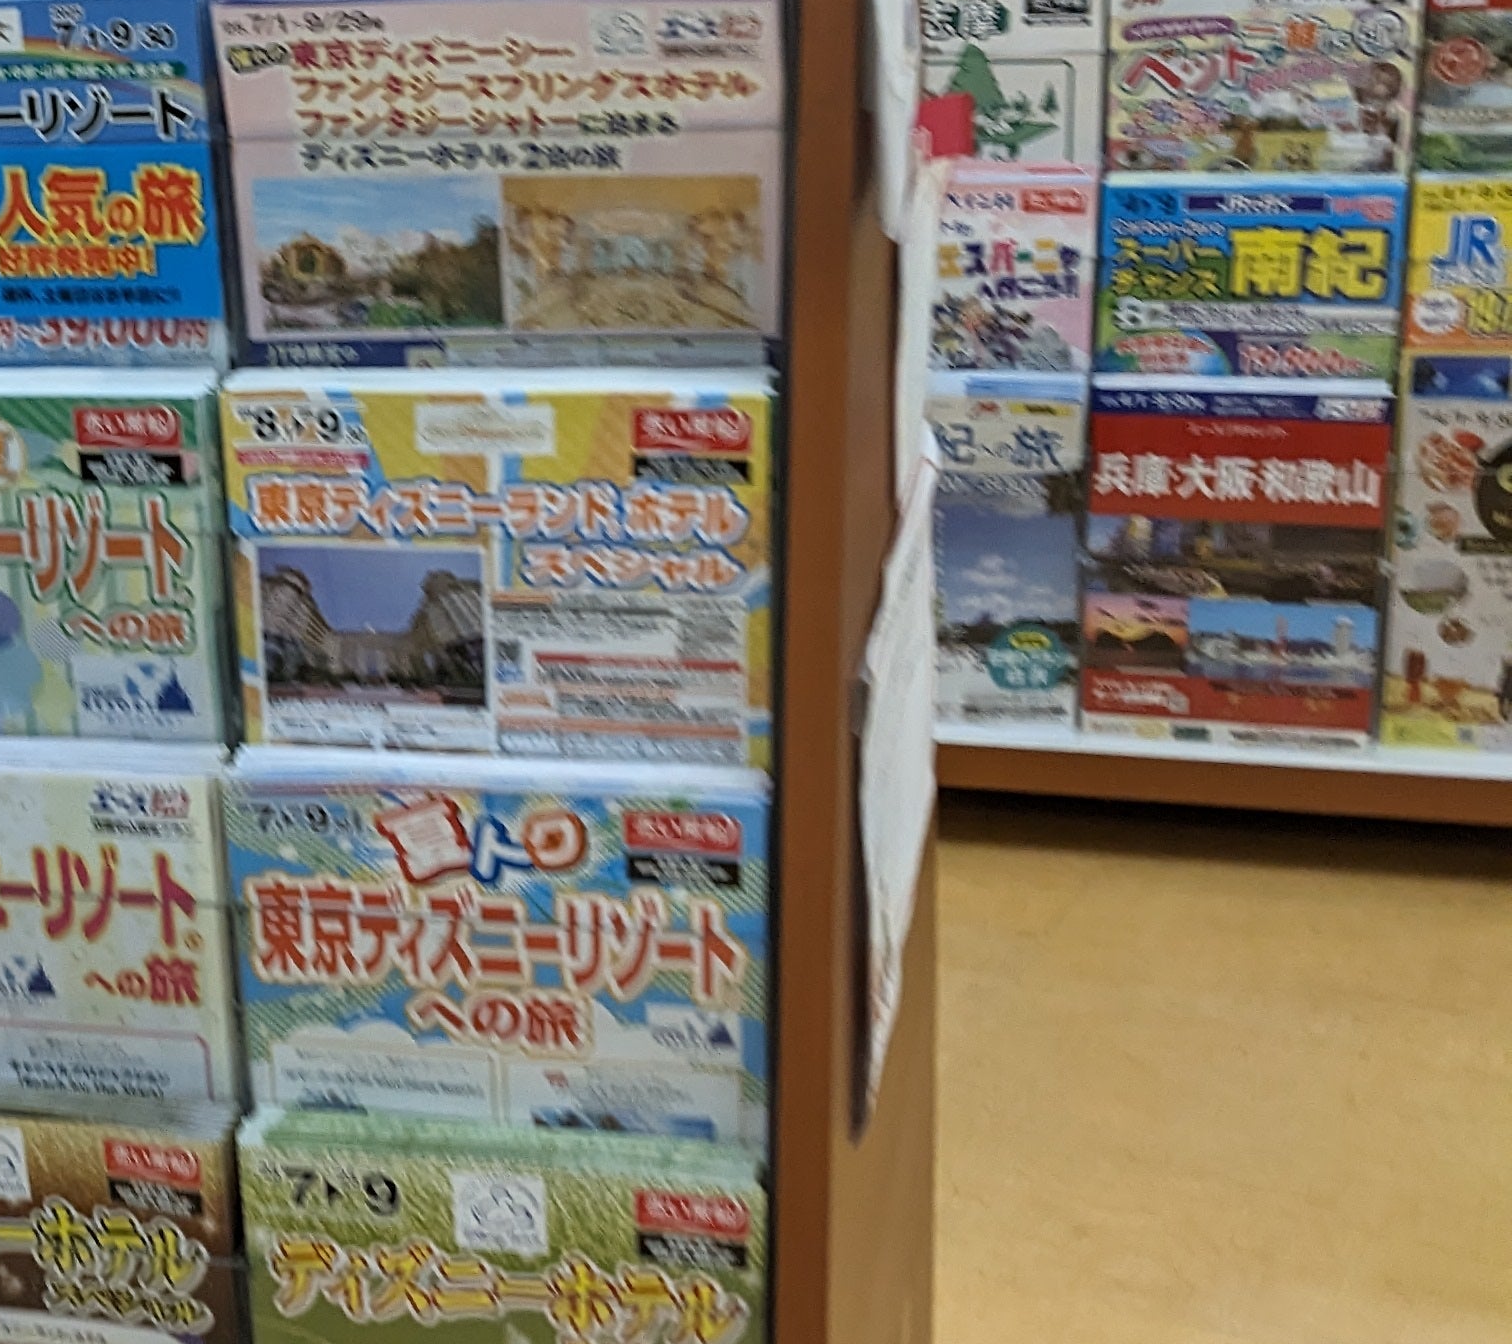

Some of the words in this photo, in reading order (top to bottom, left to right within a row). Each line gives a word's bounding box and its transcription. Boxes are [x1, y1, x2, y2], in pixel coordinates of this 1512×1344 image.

[1229, 225, 1390, 299] 南紀
[61, 605, 192, 653] への旅
[245, 871, 747, 1001] 東京ディズニーリゾート
[84, 955, 201, 1006] への旅
[407, 989, 593, 1055] への旅
